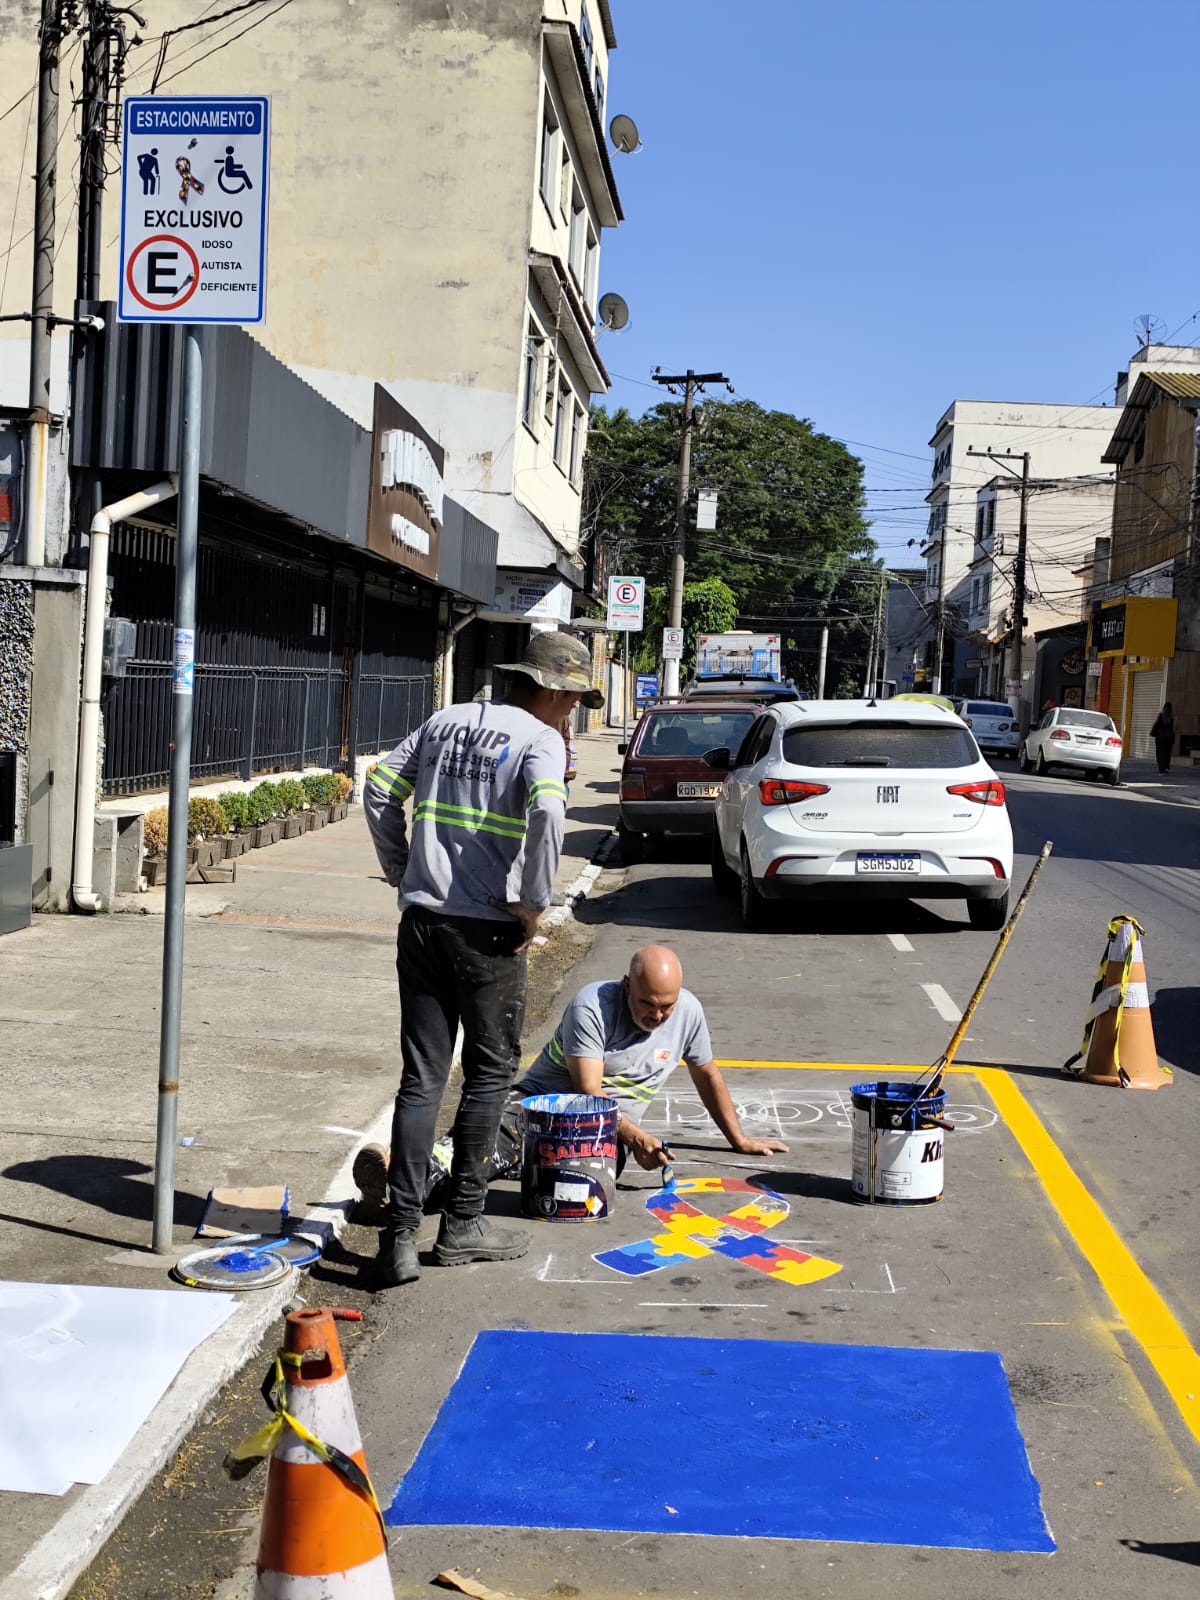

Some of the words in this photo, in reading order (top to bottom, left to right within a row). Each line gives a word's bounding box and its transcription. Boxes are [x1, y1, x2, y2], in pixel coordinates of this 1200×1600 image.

[136, 111, 255, 127] ESTACIONAMENTO
[144, 210, 243, 228] EXCLUSIVO
[201, 240, 233, 249] IDOSO
[147, 252, 178, 294] E
[201, 261, 242, 270] AUTISTA
[200, 283, 257, 292] DEFICIENTE
[622, 587, 631, 600] E
[428, 722, 511, 750] LUQUIP
[876, 785, 900, 803] FIAT
